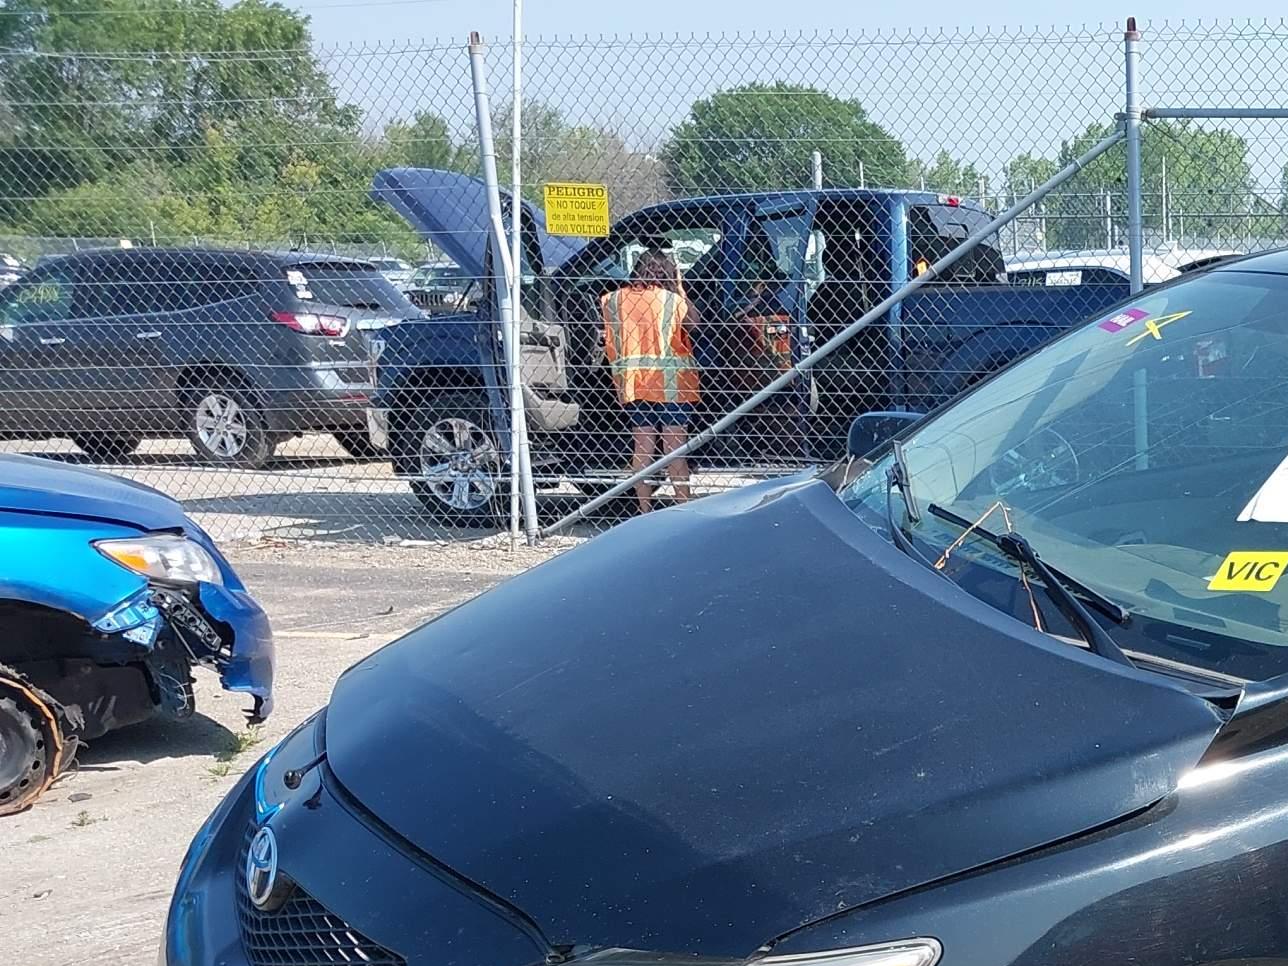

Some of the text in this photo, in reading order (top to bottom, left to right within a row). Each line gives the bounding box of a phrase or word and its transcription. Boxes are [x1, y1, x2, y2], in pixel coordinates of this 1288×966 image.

[548, 186, 604, 197] PELIGRO
[556, 200, 597, 210] NO TOQUE
[551, 212, 604, 222] de alta tension
[570, 223, 607, 234] VOLTIOS
[1226, 561, 1280, 582] VIC
